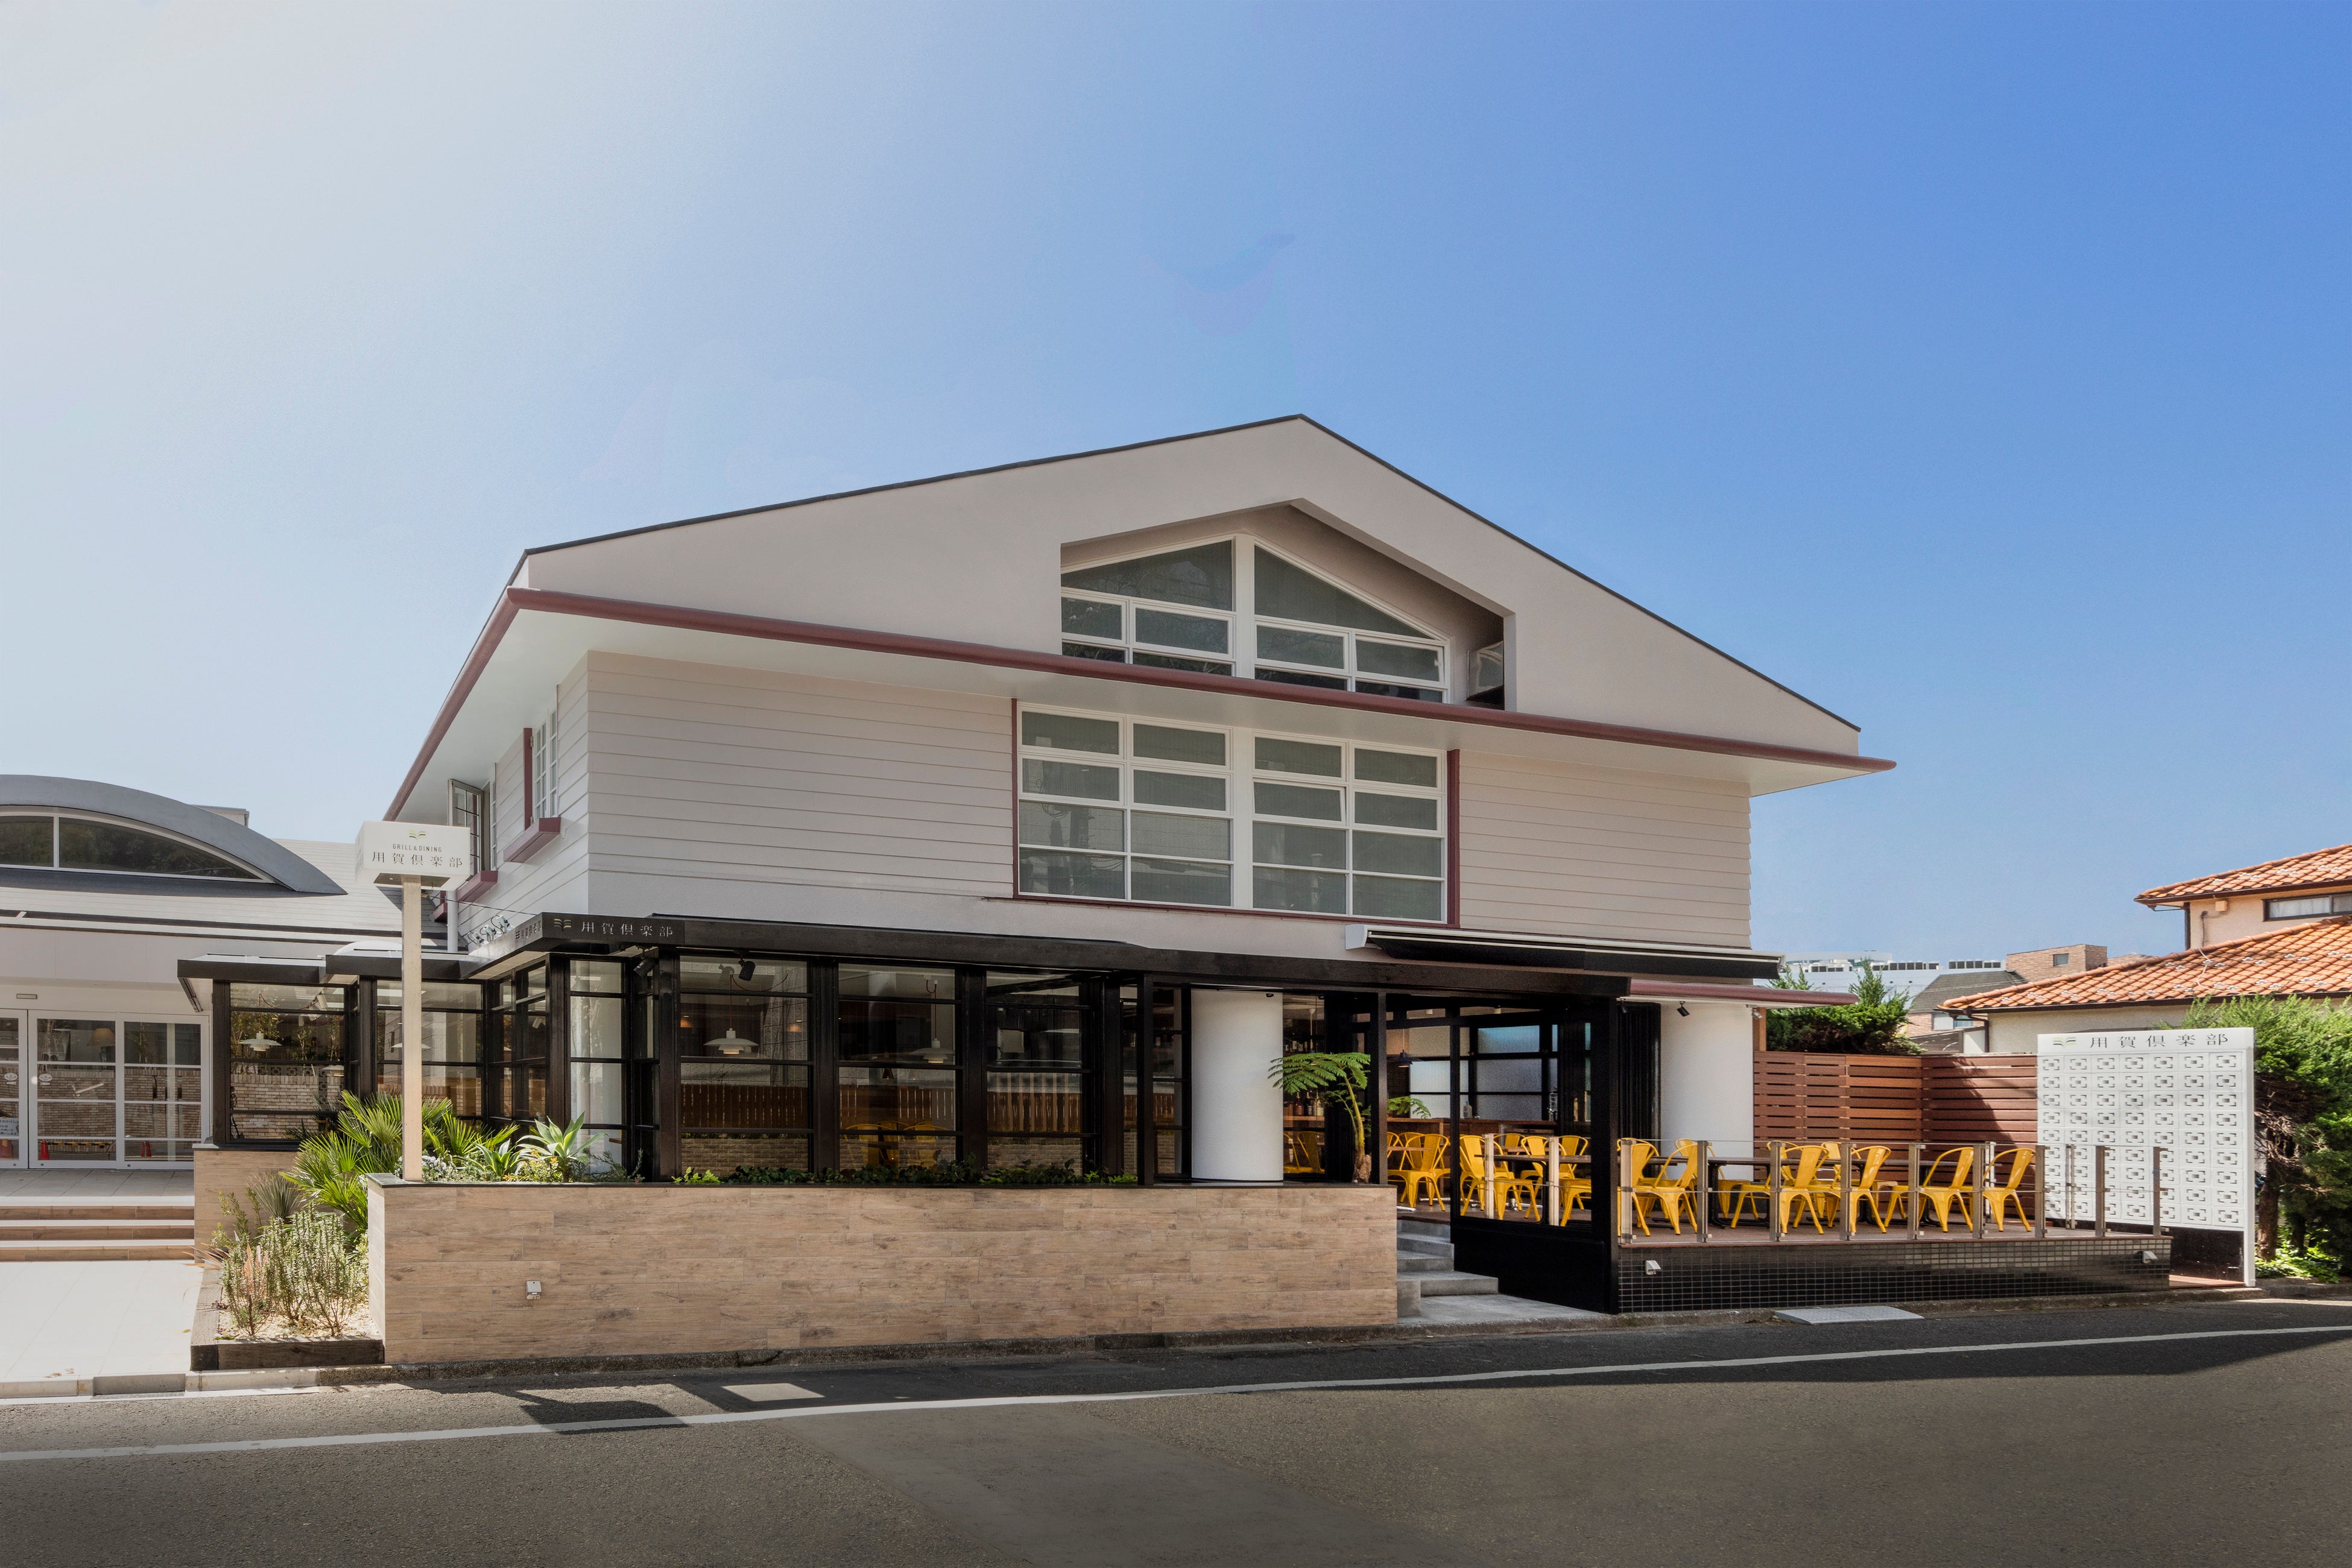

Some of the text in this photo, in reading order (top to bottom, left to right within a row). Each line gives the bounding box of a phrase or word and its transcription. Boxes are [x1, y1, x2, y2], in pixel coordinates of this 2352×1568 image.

[393, 844, 442, 852] GRILL&DINING
[371, 851, 463, 868] 用賀倶楽部
[581, 921, 673, 937] 用賀倶楽部
[2090, 1033, 2228, 1048] 用賀倶楽部
